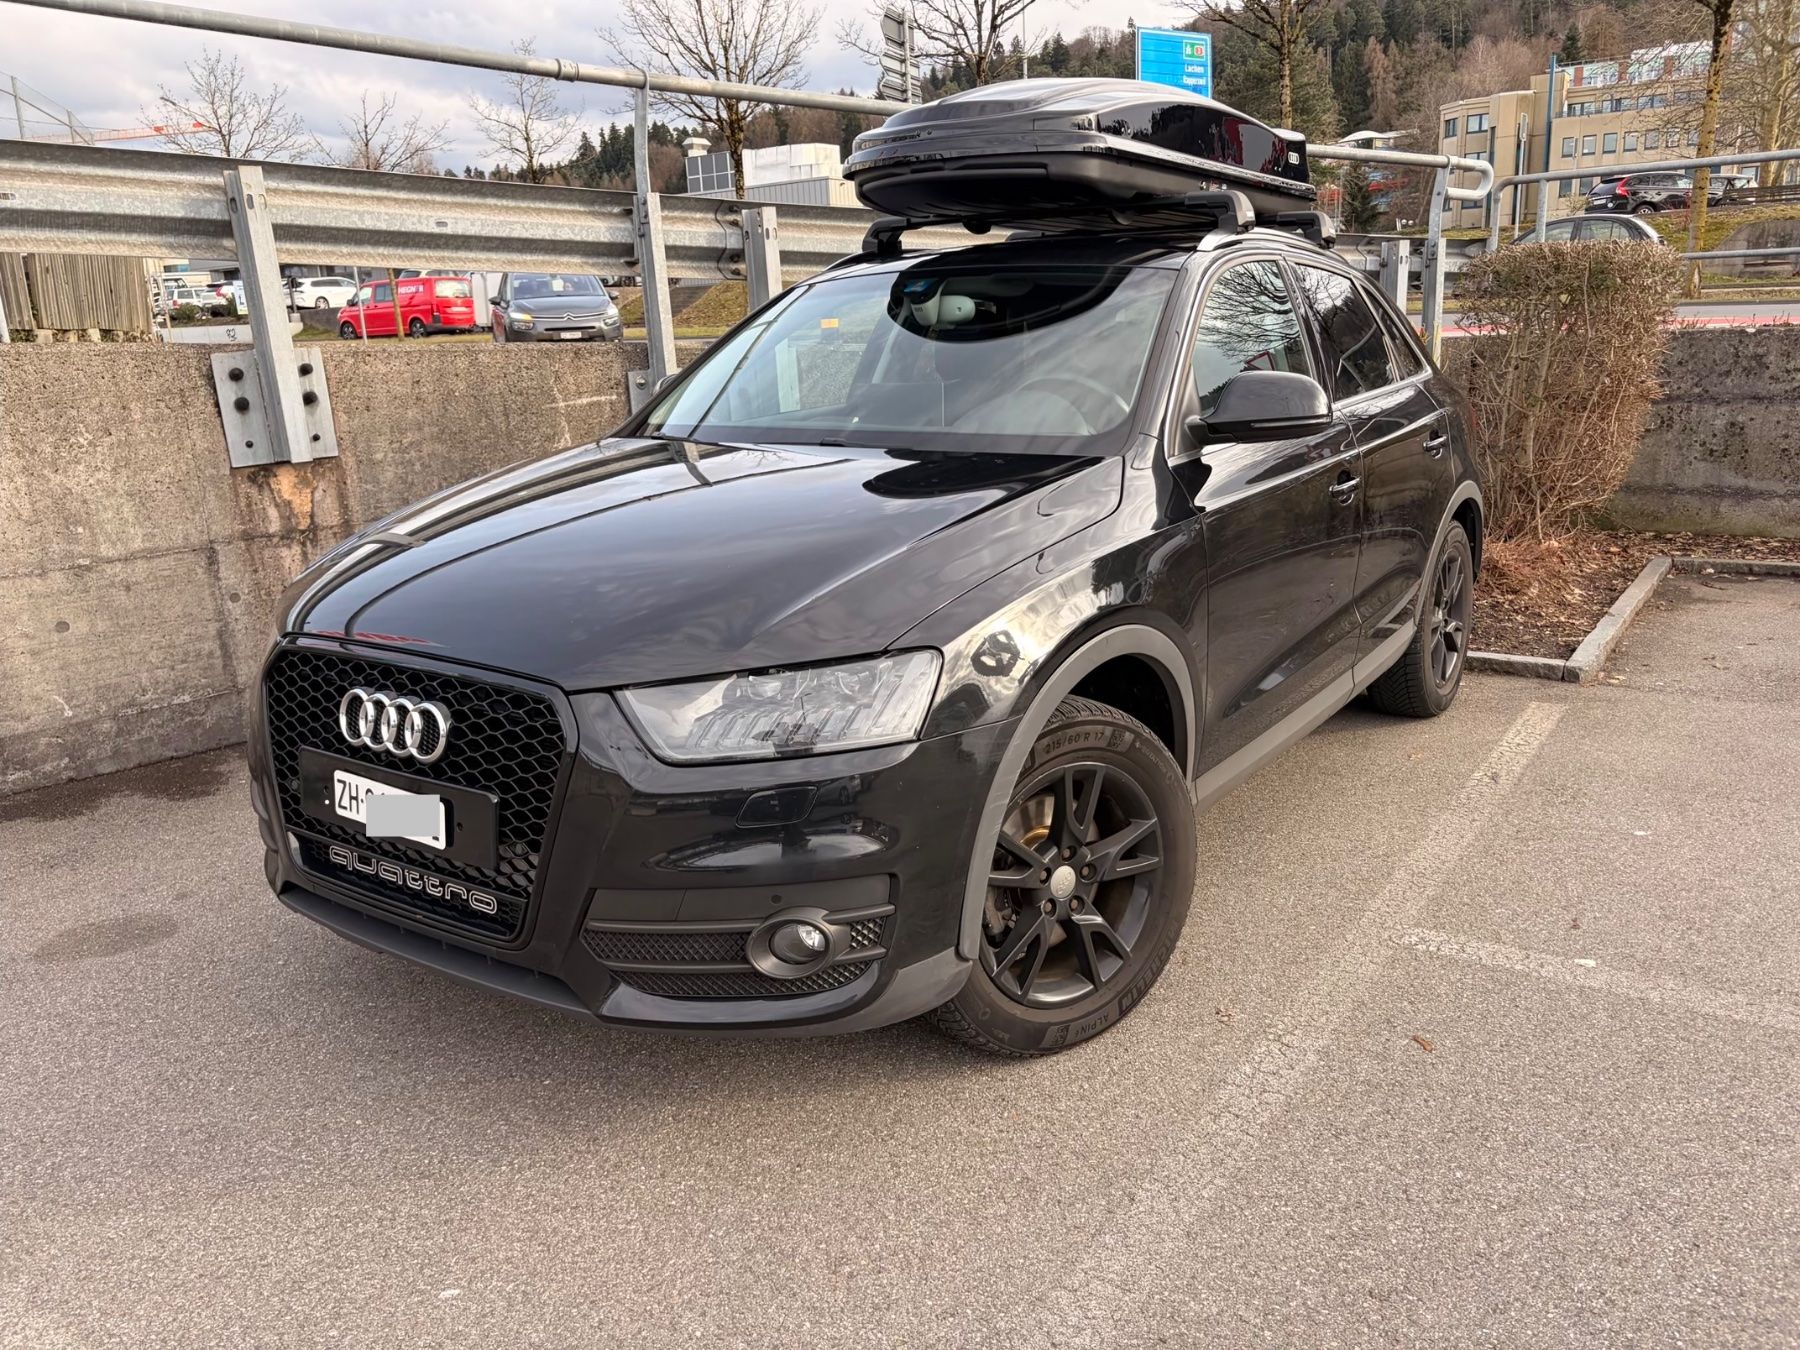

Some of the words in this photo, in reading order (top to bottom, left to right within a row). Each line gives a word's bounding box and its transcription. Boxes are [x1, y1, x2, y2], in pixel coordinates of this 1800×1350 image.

[1044, 733, 1081, 754] 215/60
[1083, 732, 1091, 742] R
[1094, 732, 1105, 742] 17
[329, 845, 497, 914] quattro
